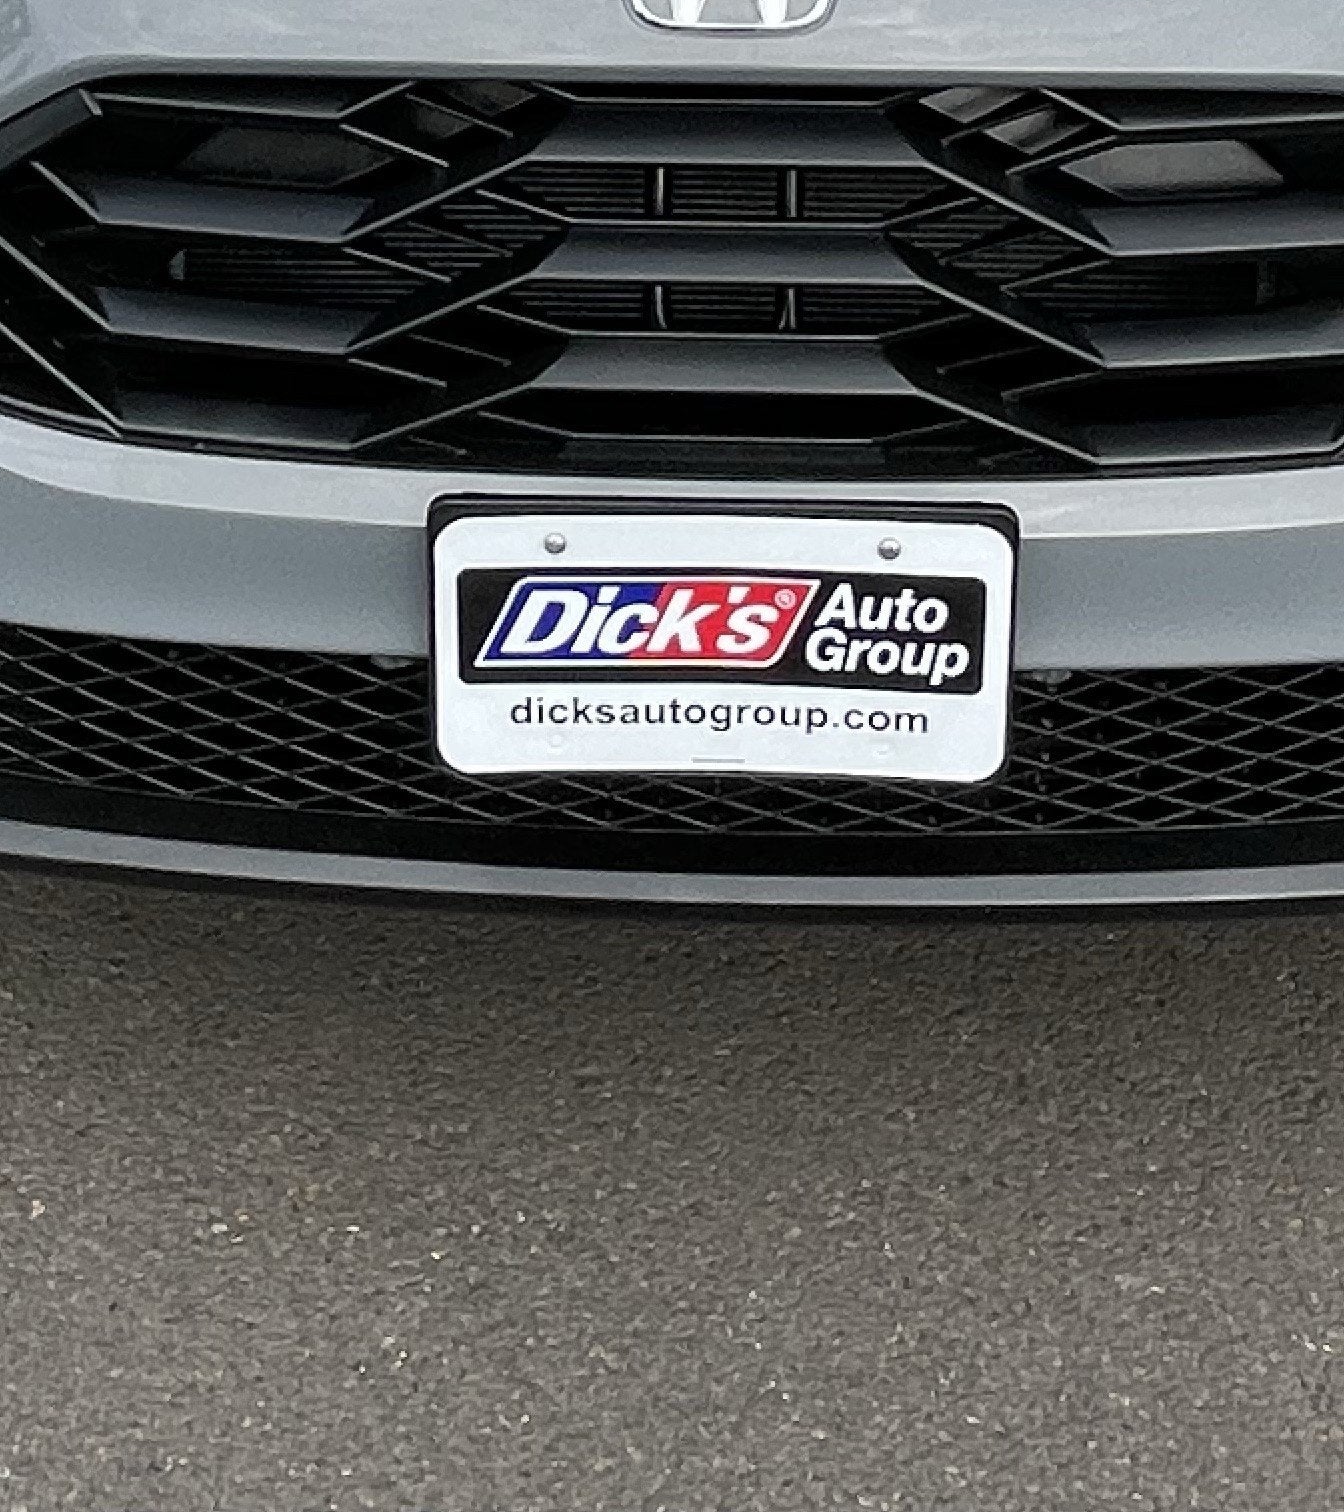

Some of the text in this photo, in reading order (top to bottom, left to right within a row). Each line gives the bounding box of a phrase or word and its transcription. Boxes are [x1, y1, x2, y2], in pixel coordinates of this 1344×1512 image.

[499, 585, 779, 656] Dick's
[813, 581, 949, 635] Auto
[804, 626, 971, 686] Group
[509, 695, 929, 734] dicksautogroup.com
